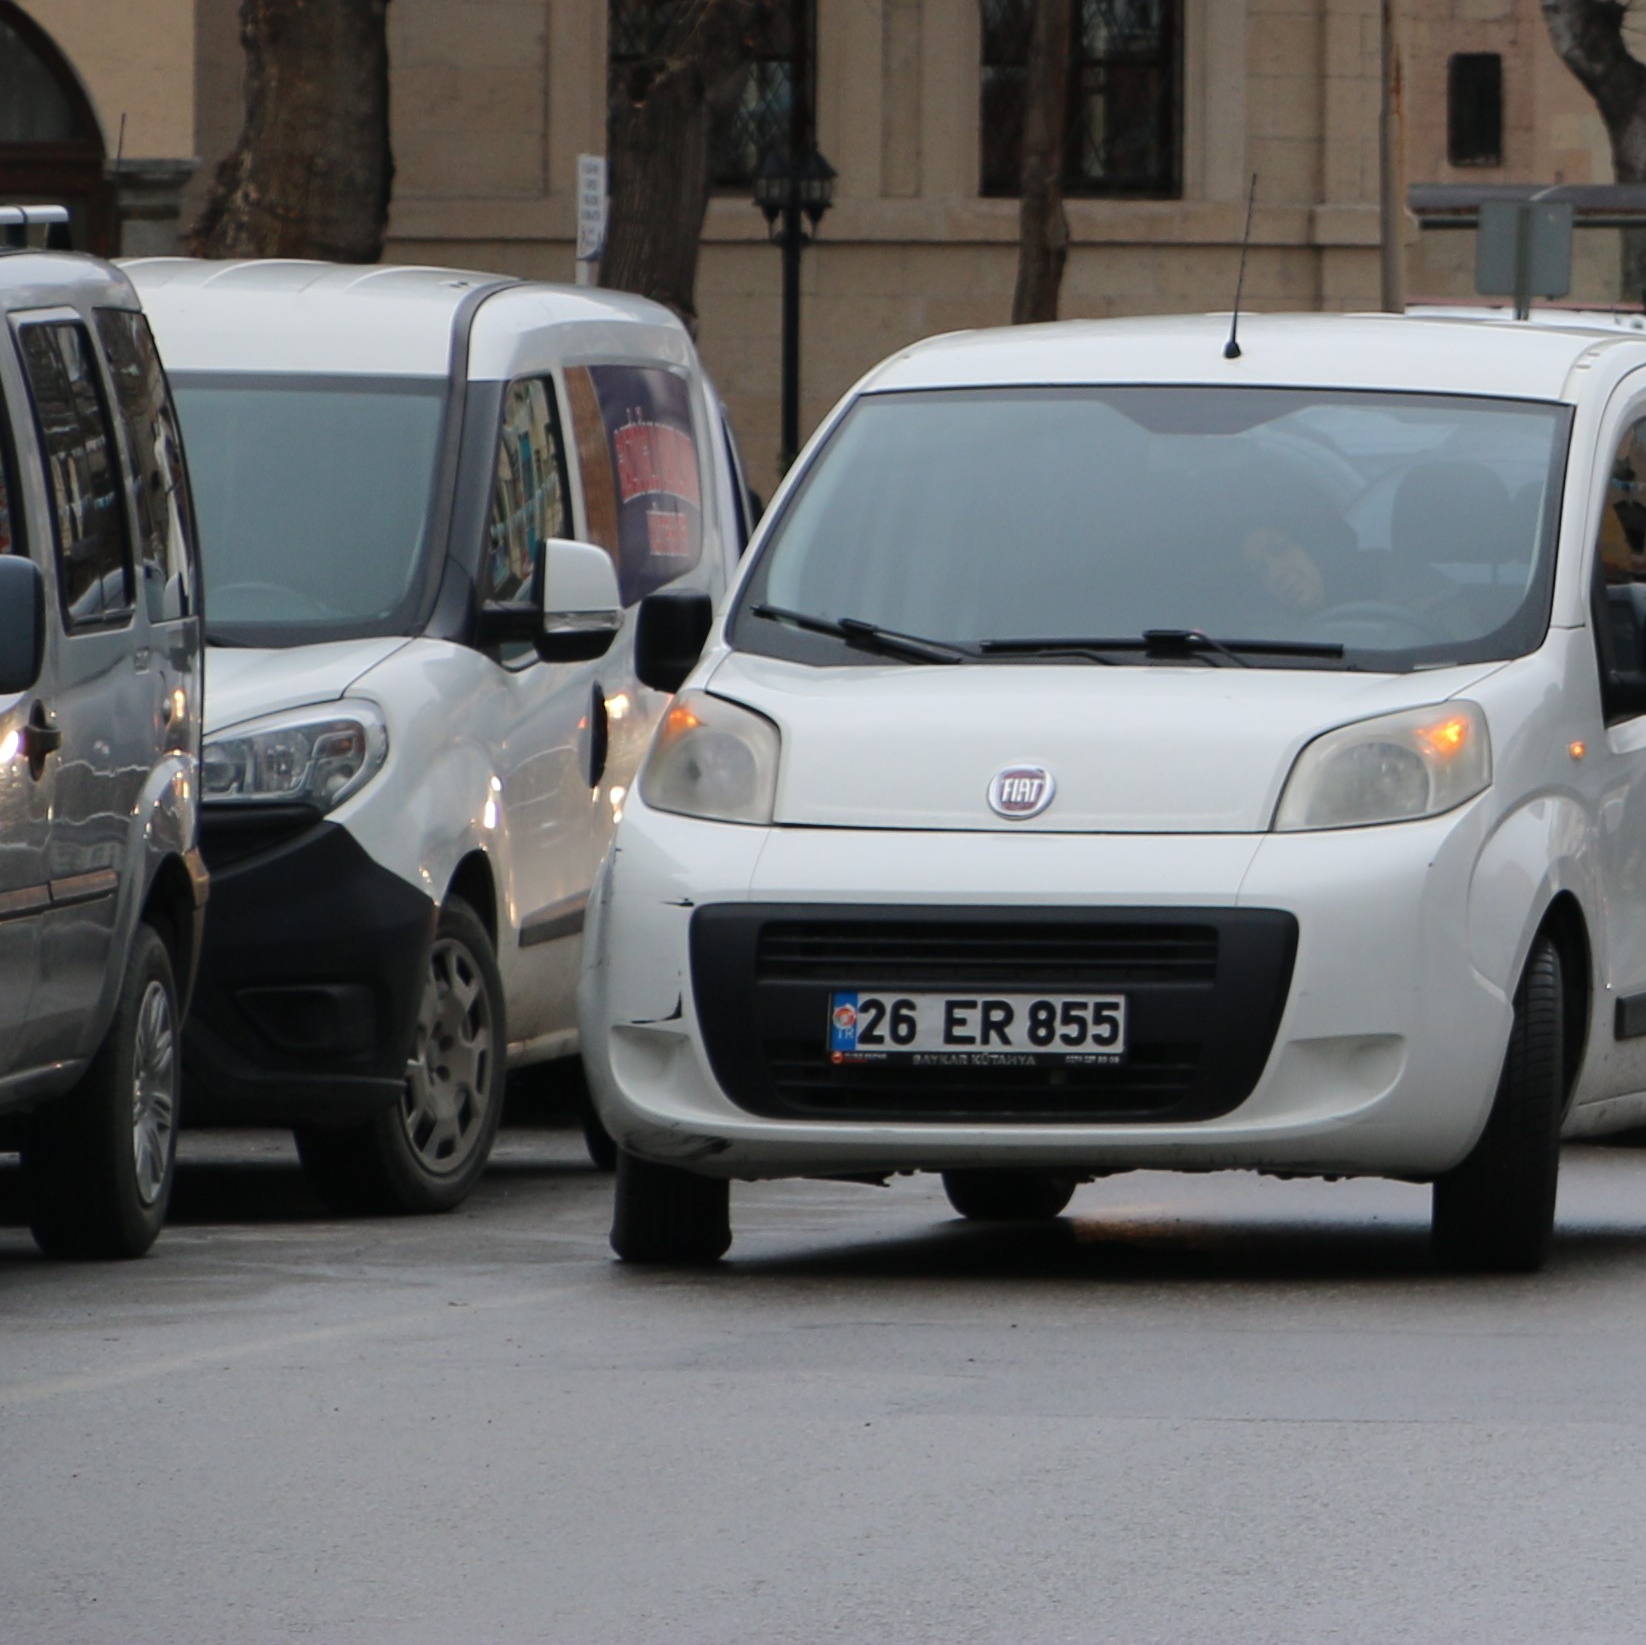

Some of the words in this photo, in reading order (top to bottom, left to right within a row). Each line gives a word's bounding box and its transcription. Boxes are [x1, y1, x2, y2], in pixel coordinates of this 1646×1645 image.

[1001, 777, 1042, 803] FIAT
[856, 998, 917, 1046] 26
[943, 999, 1014, 1046] ER
[1027, 1000, 1120, 1047] 855
